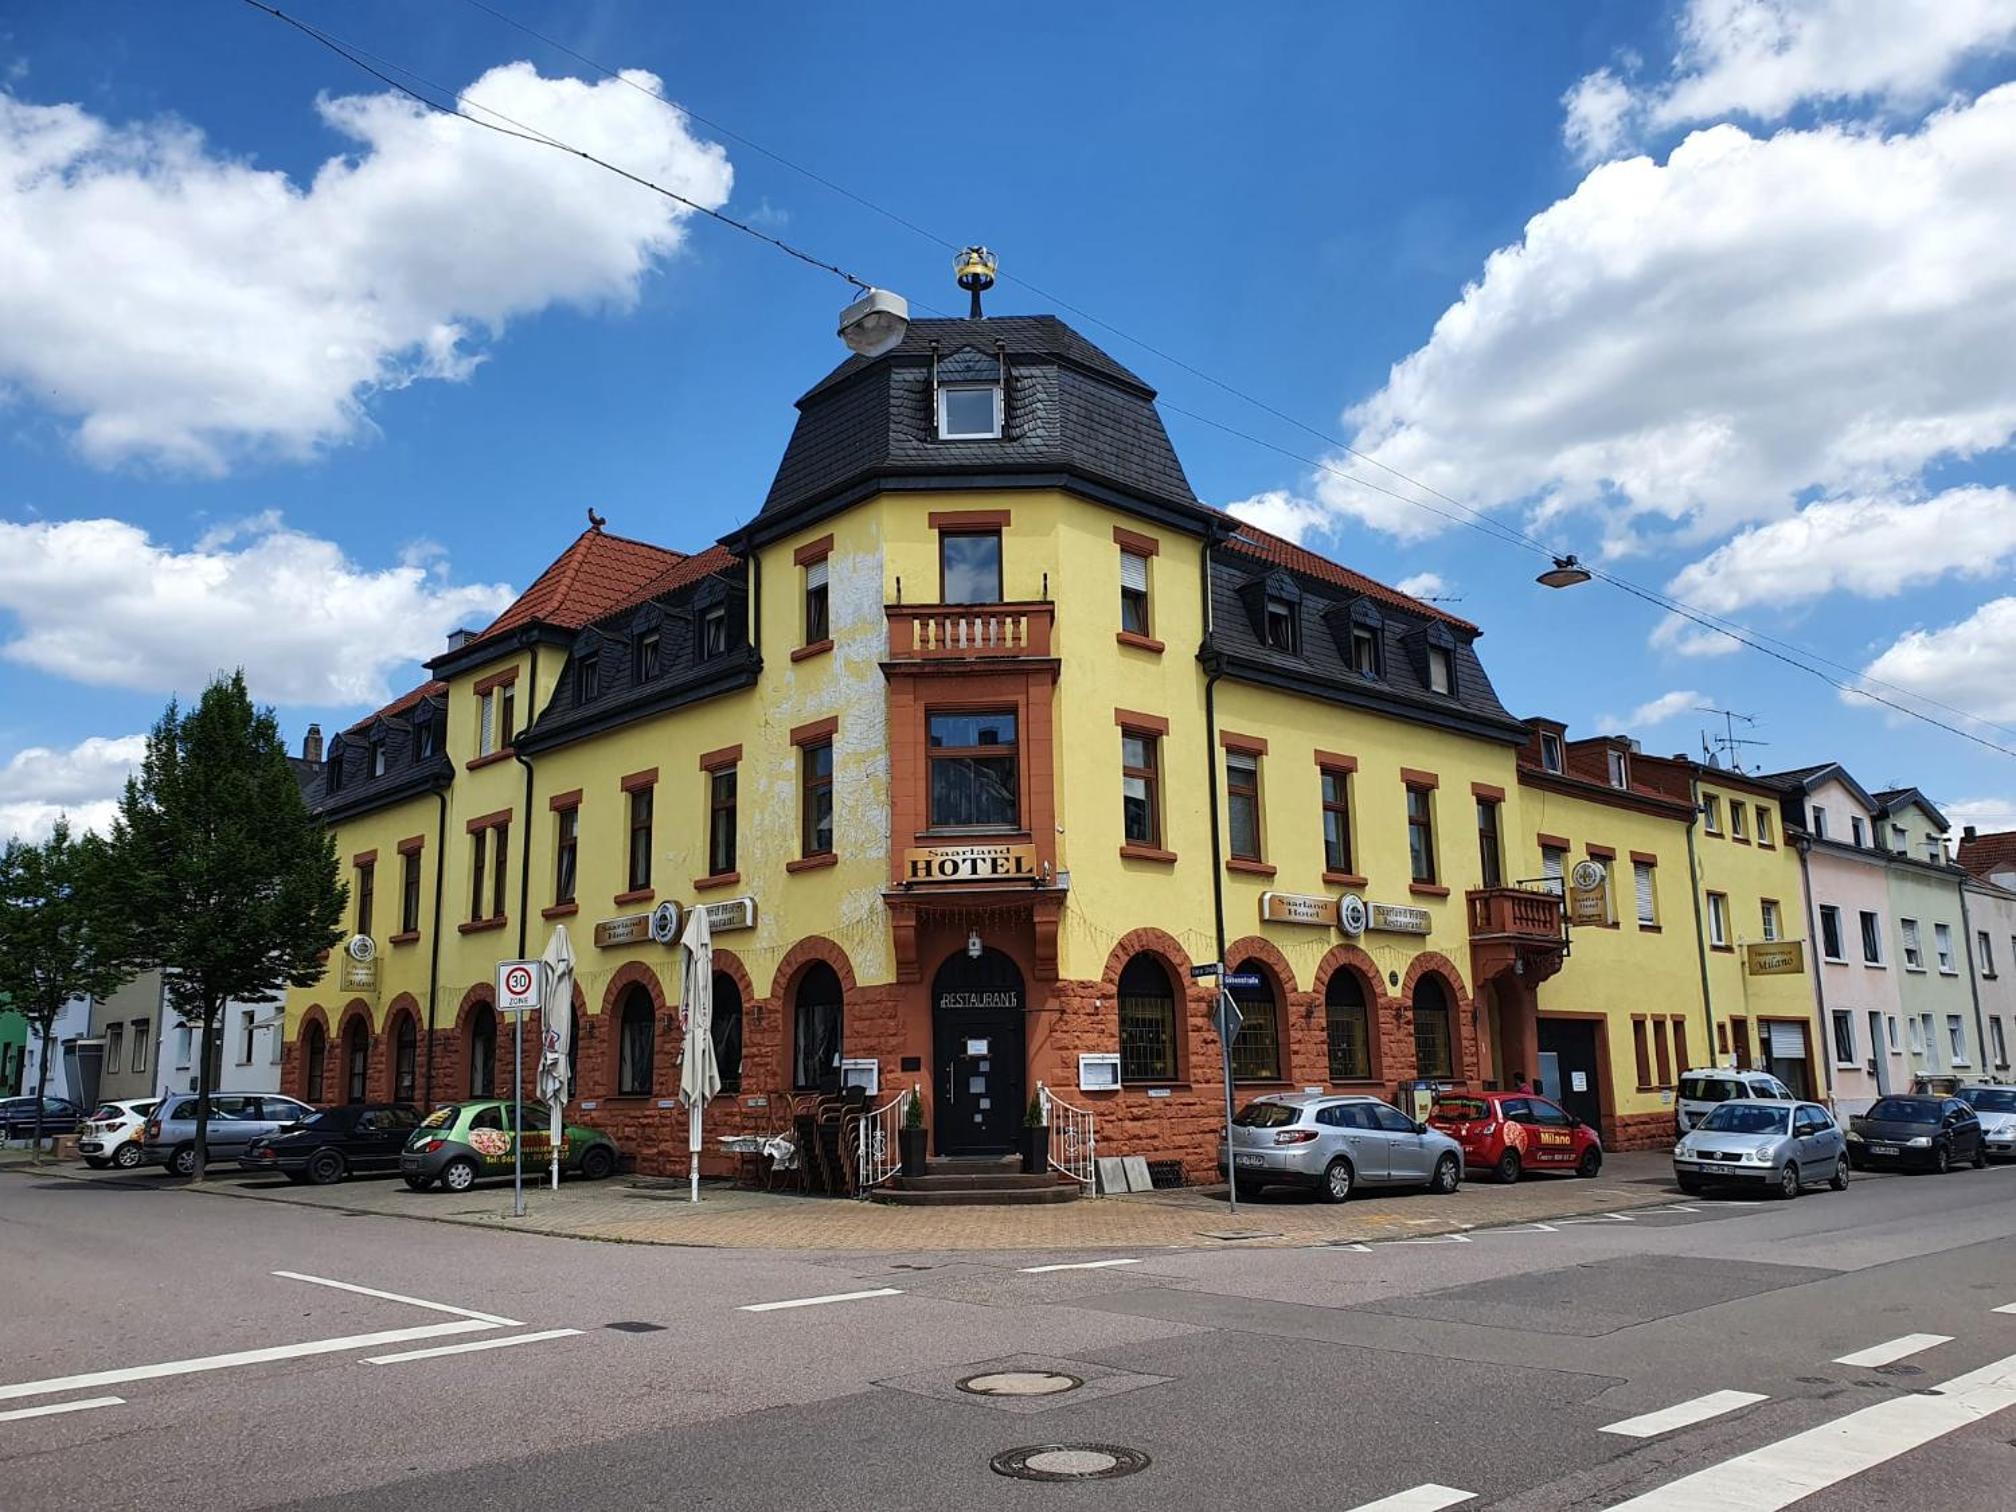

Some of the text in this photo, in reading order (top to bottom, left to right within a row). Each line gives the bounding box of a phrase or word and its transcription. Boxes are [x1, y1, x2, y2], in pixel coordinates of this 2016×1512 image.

[928, 847, 1011, 857] Saarland
[910, 856, 1033, 877] HOTEL
[722, 903, 743, 916] Hotel
[1277, 899, 1328, 910] Saarland
[1288, 909, 1320, 918] Hotel
[1377, 906, 1427, 920] Saarland Hotel
[602, 919, 642, 931] Saarland
[708, 917, 735, 927] aurant
[1384, 917, 1422, 929] Restaurant
[608, 929, 634, 940] Hotel
[1753, 957, 1794, 970] Milano
[511, 974, 527, 988] 30
[509, 997, 529, 1005] ZONE
[941, 992, 1017, 1008] RESTAURANT
[1540, 1132, 1571, 1145] Milano
